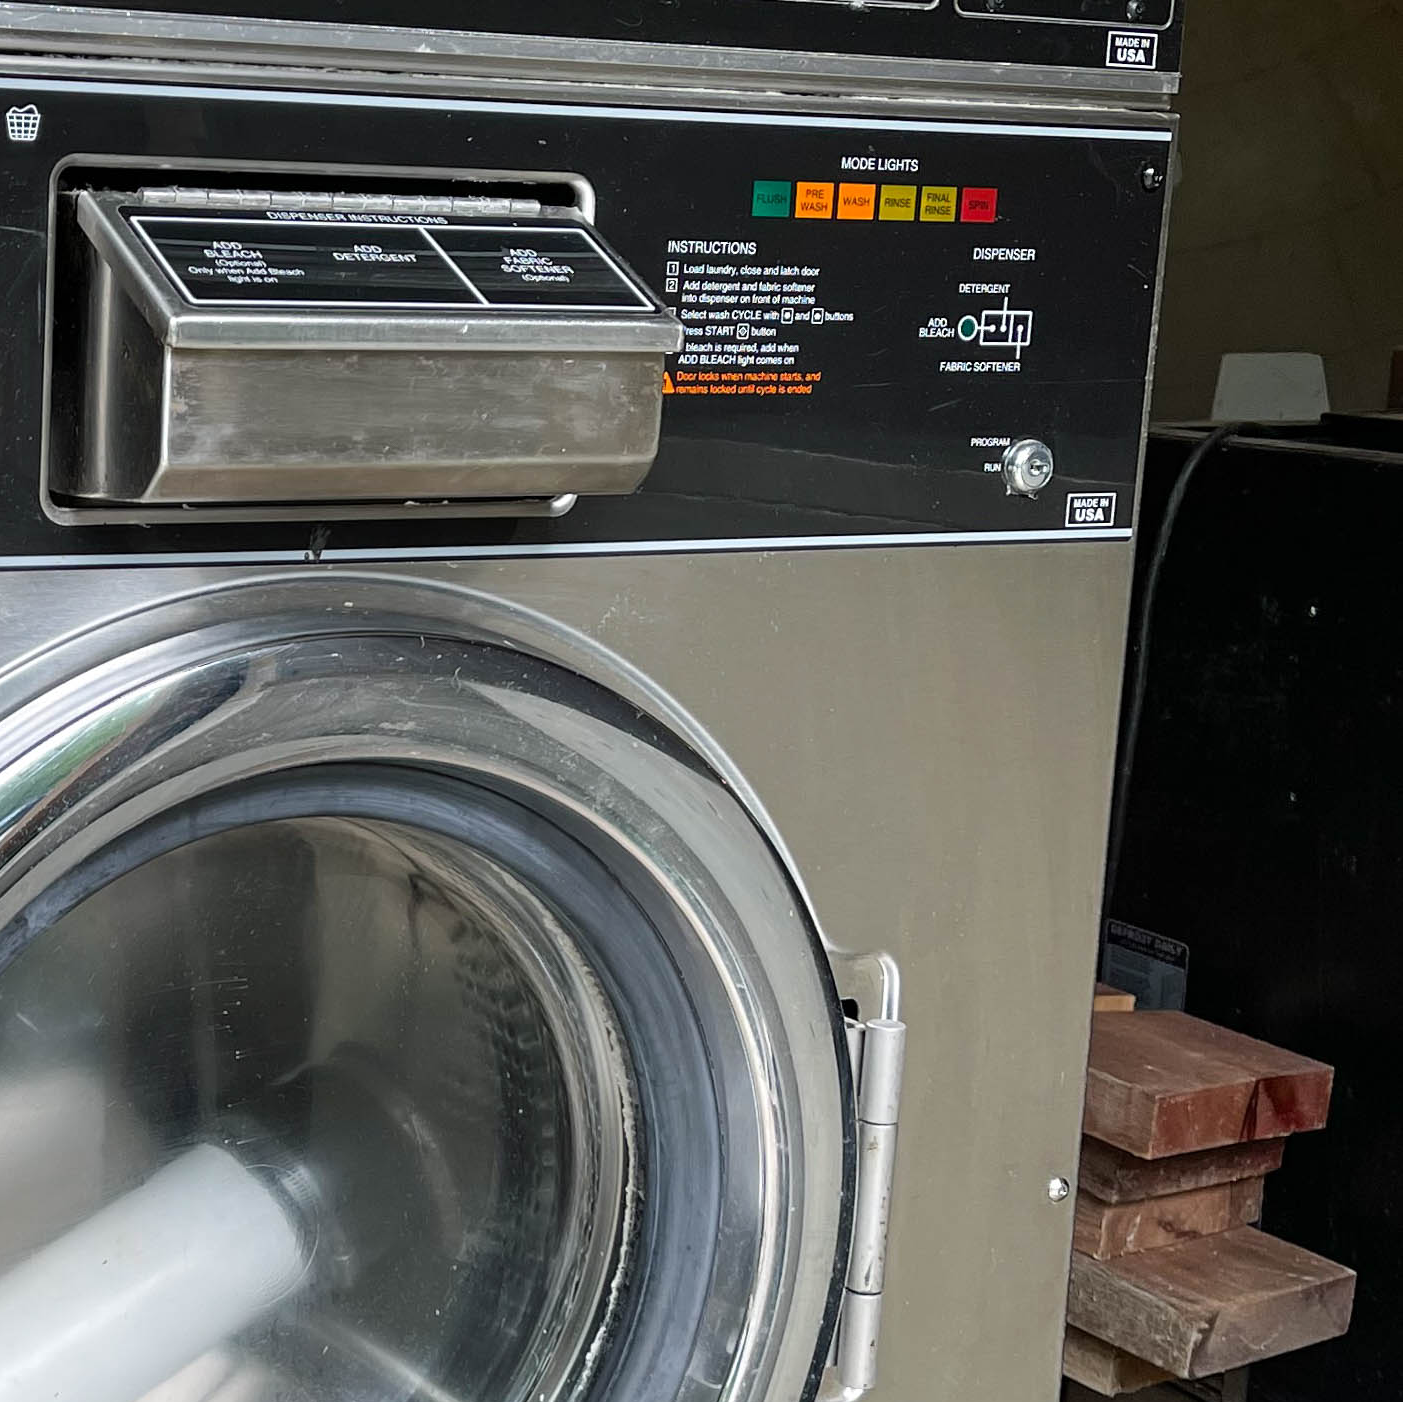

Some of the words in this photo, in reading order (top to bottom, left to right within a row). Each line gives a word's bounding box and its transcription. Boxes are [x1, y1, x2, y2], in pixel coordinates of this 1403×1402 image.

[1115, 38, 1139, 47] MADE
[1141, 39, 1150, 48] IN
[1117, 48, 1146, 62] USA
[841, 157, 875, 170] MODE
[878, 159, 918, 171] LIGHTS
[757, 194, 787, 204] FLUSH
[806, 189, 824, 199] PRE
[927, 193, 950, 203] FINAL
[801, 201, 828, 212] WASH
[843, 197, 870, 207] WASH
[885, 198, 911, 208] RINSE
[969, 200, 989, 210] SPIN
[925, 205, 951, 215] RINSE
[266, 212, 347, 222] DISPENSER
[347, 213, 447, 225] INSTRUCTIONS
[213, 241, 242, 250] ADD
[353, 245, 382, 253] ADD
[668, 241, 757, 255] INSTRUCTIONS
[204, 250, 262, 259] BLEACH
[333, 253, 417, 262] DETERGENT
[510, 249, 537, 257] ADD
[973, 248, 1035, 260] DISPENSER
[504, 257, 553, 265] FABRIC
[501, 265, 574, 274] SOFTENER
[684, 264, 705, 274] Load
[707, 265, 738, 276] laundry,
[740, 265, 761, 275] close
[764, 266, 779, 275] and
[781, 266, 799, 276] latch
[801, 267, 819, 276] door
[683, 281, 699, 290] Add
[702, 282, 740, 292] detergent
[742, 282, 757, 291] and
[759, 282, 781, 291] fabric
[783, 283, 815, 292] softener
[959, 284, 1010, 293] DETERGENT
[682, 294, 697, 303] into
[699, 294, 738, 305] dispenser
[752, 295, 771, 304] front
[772, 295, 780, 304] of
[782, 295, 815, 304] machine
[681, 310, 707, 319] Select
[709, 311, 729, 319] wash
[732, 311, 761, 320] CYCLE
[763, 311, 779, 320] with
[795, 312, 810, 320] and
[825, 312, 853, 321] buttons
[928, 318, 947, 327] ADD
[705, 326, 735, 336] START
[751, 327, 776, 336] button
[919, 328, 954, 337] BLEACH
[678, 355, 698, 364] ADD
[700, 355, 736, 365] BLEACH
[738, 355, 754, 366] light
[756, 356, 783, 365] comes
[785, 357, 794, 365] on
[940, 362, 972, 372] FABRIC
[974, 362, 1020, 372] SOFTENER
[971, 438, 1010, 446] PROGRAM
[984, 463, 1001, 472] RUN
[1073, 499, 1098, 507] MADE
[1100, 499, 1109, 507] IN
[1075, 509, 1104, 521] USA
